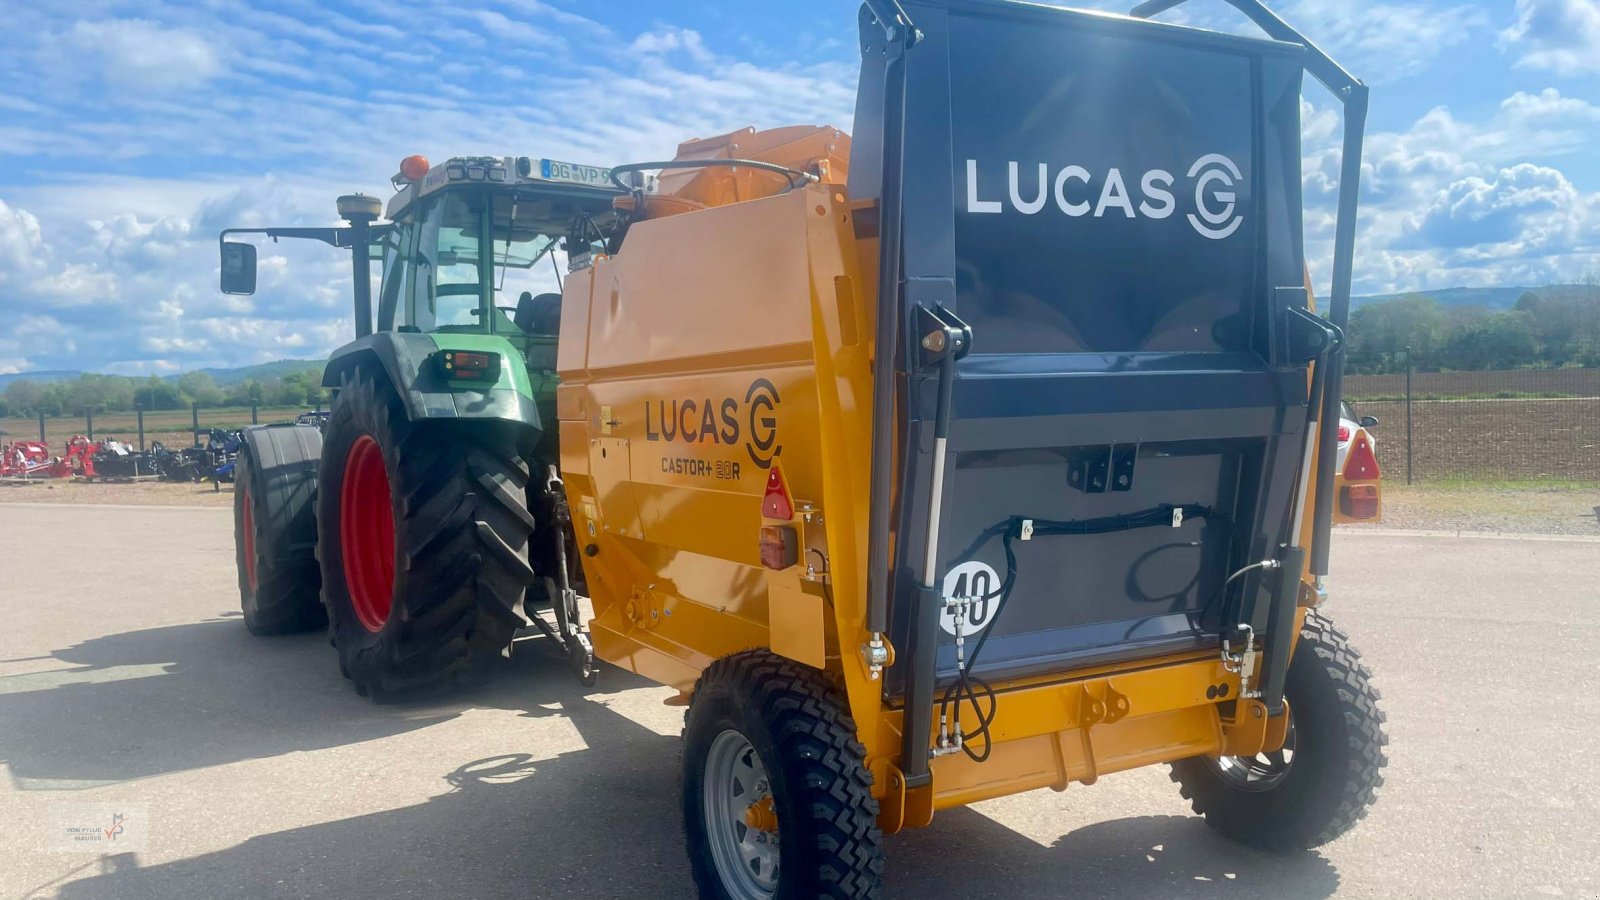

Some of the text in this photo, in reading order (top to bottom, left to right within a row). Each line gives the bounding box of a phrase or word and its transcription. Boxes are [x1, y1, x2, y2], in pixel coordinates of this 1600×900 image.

[551, 163, 570, 179] OG
[580, 168, 598, 183] VP
[966, 159, 1176, 219] LUCAS
[645, 398, 740, 446] LUCAS
[662, 457, 740, 480] CASTOR+ 20R
[947, 570, 990, 626] 40
